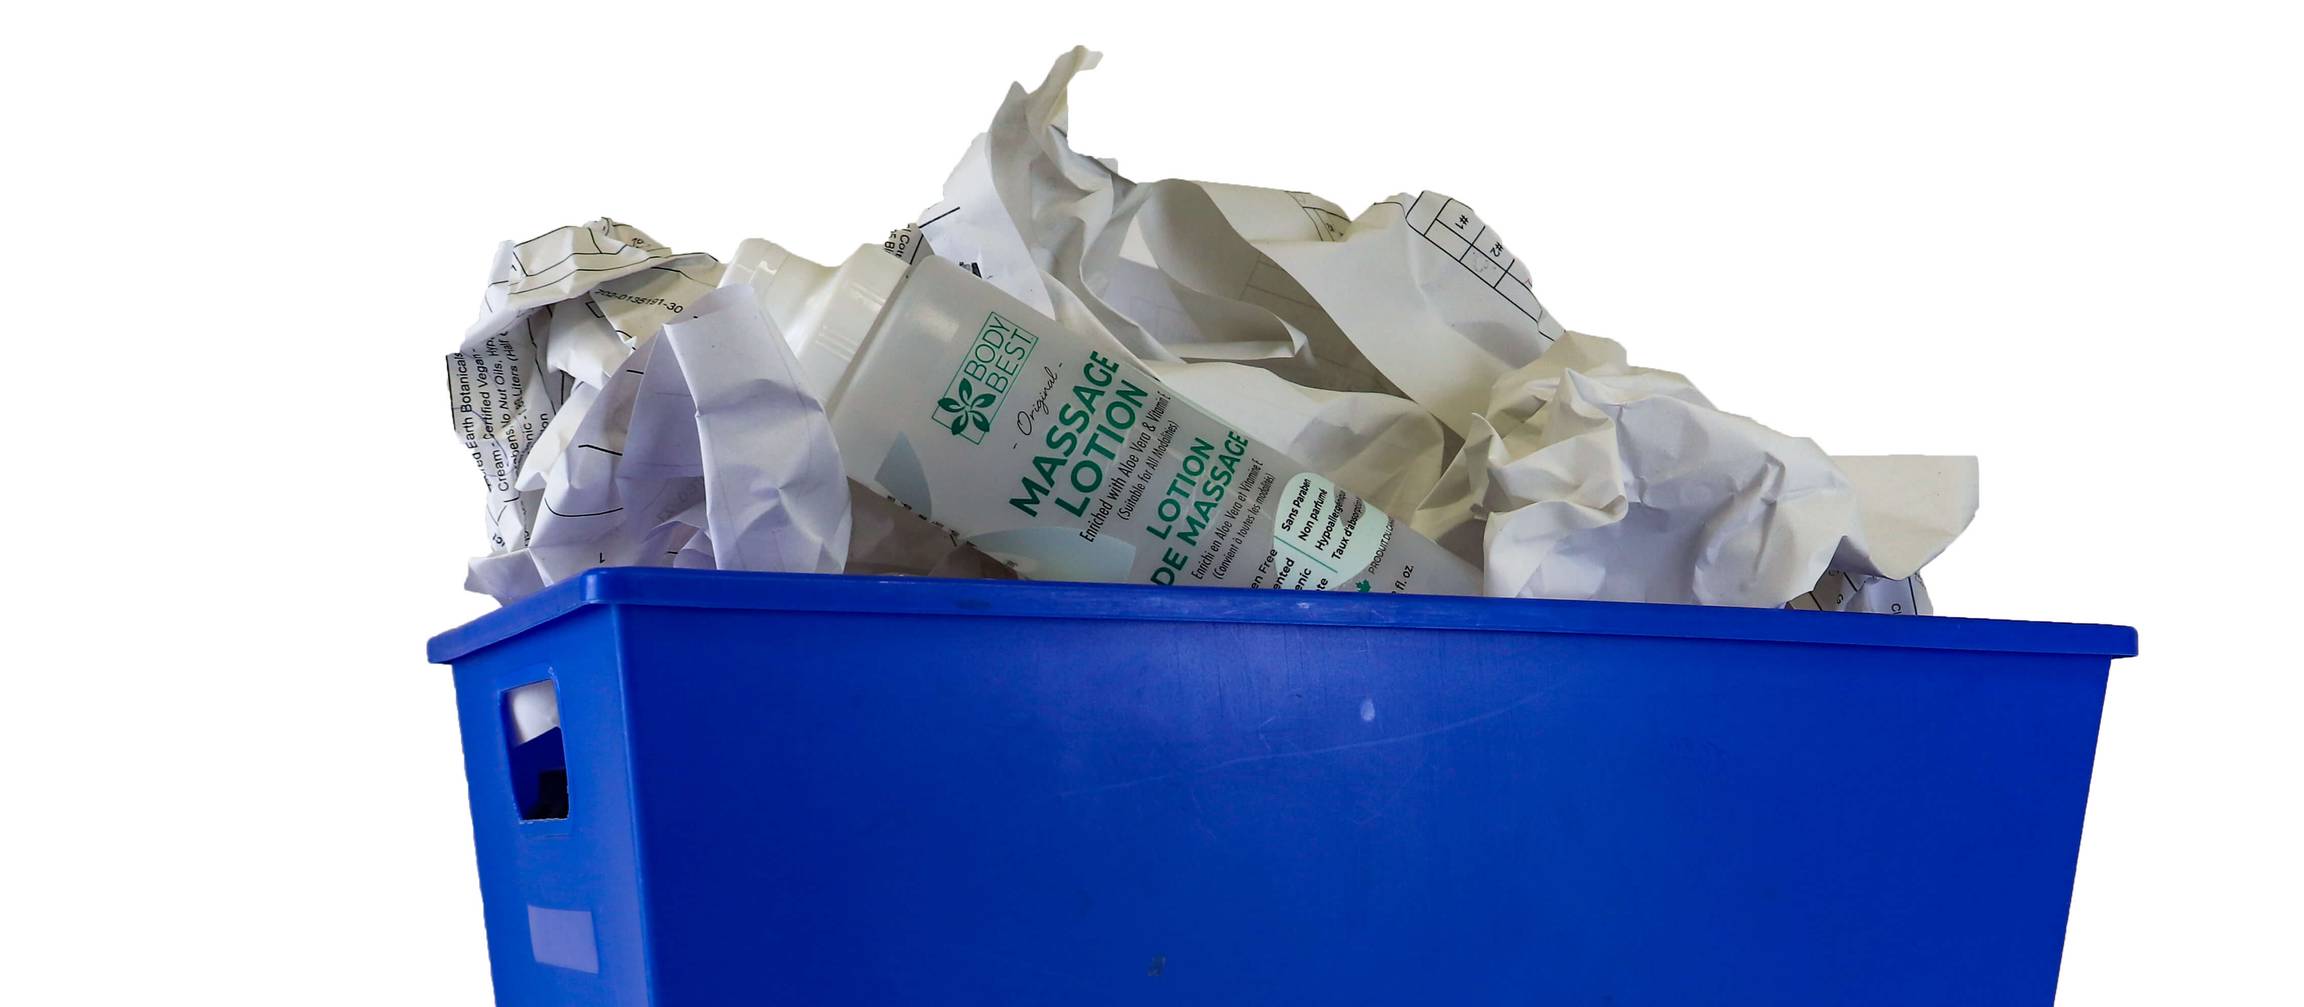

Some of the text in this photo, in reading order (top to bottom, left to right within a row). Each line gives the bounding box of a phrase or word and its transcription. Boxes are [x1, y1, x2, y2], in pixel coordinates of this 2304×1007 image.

[963, 316, 1012, 382] BODY
[985, 328, 1032, 393] BEST
[454, 352, 473, 413] Botanicals
[473, 353, 489, 388] Vegan
[480, 391, 495, 440] Certified
[497, 389, 509, 410] Nut
[1016, 366, 1058, 436] Original
[1146, 398, 1169, 423] Vitamin
[462, 417, 478, 449] Earth
[1009, 350, 1120, 518] MASSAGE
[1130, 432, 1152, 457] Vera
[1142, 421, 1156, 433] &
[1055, 379, 1149, 518] LOTION
[491, 450, 510, 492] Cream
[1117, 421, 1181, 521] (Suitable for All Modalities)
[1118, 453, 1140, 480] Aloe
[1239, 466, 1259, 494] Vitamine
[1107, 476, 1128, 500] with
[1146, 437, 1215, 541] LOTION
[1237, 493, 1248, 505] et
[1281, 478, 1312, 532] Sans Paraben
[1079, 499, 1114, 543] Enriched
[1150, 431, 1249, 586] DE MASSAGE
[1224, 503, 1243, 524] Vera
[1298, 487, 1328, 542] Non parfumé
[1210, 539, 1223, 552] en
[1212, 542, 1240, 580] (Convient
[1237, 511, 1256, 539] toutes
[1249, 503, 1262, 518] les
[1214, 520, 1233, 541] Aloe
[1331, 536, 1350, 560] Taux
[1191, 550, 1216, 580] Enrichi
[1258, 549, 1278, 574] Free
[1368, 539, 1389, 575] PRODUIT
[1395, 565, 1415, 591] fl. oz.
